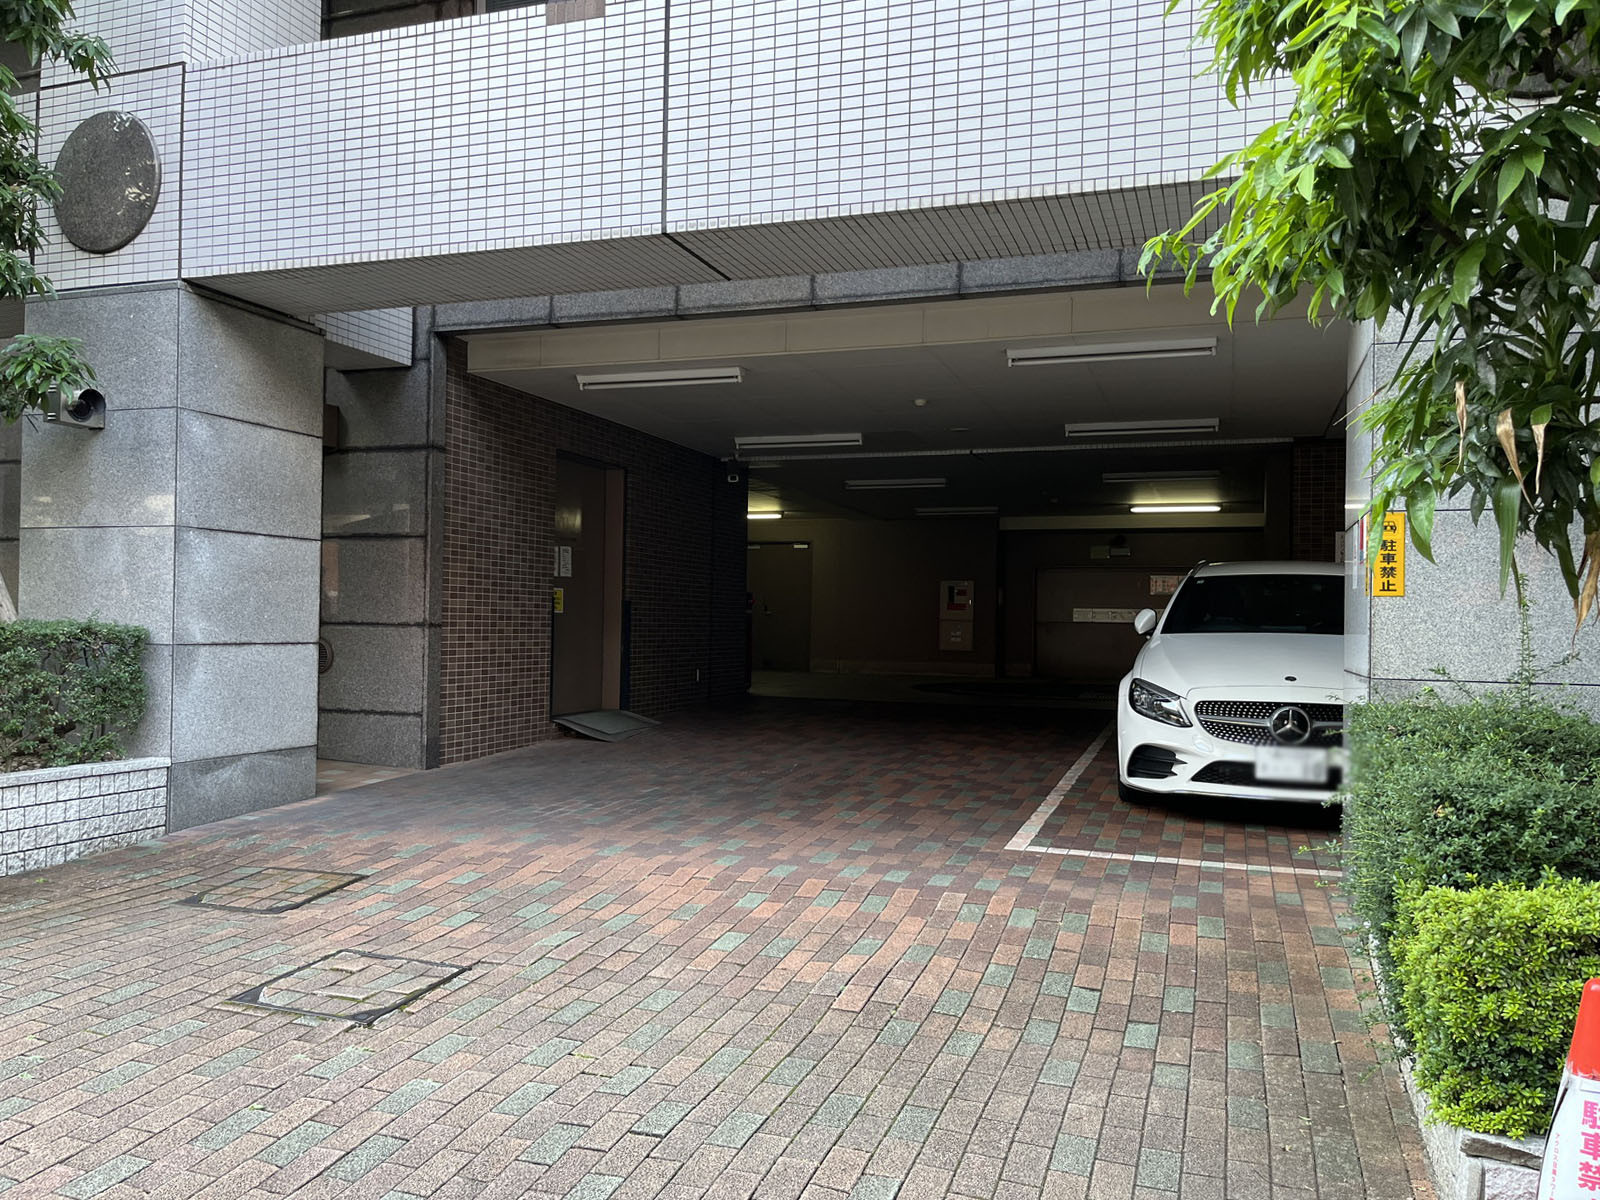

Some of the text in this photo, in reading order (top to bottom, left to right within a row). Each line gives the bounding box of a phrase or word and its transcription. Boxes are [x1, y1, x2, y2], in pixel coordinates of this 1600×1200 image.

[1380, 540, 1397, 592] 駐車禁止
[1578, 1100, 1600, 1200] 駐車禁
